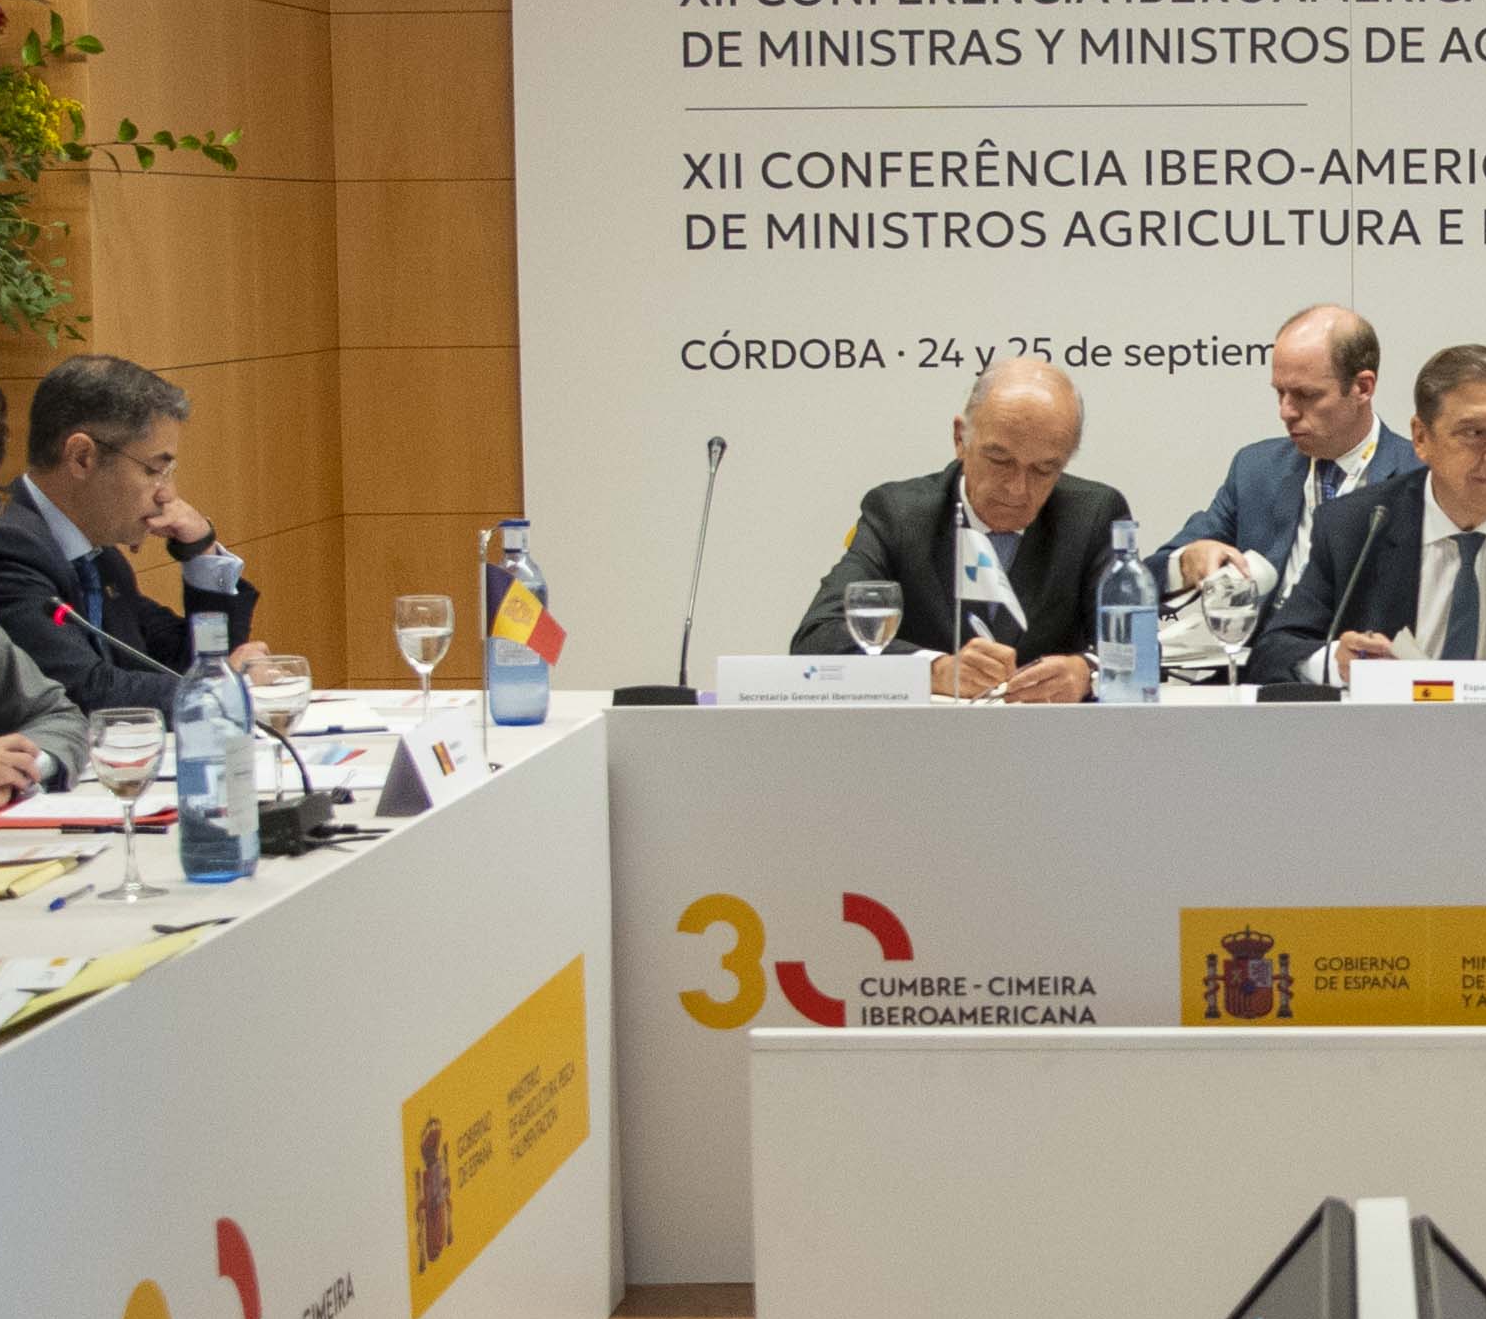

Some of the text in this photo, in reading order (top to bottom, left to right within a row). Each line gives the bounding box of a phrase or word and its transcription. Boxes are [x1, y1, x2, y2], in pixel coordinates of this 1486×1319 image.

[682, 31, 743, 68] DE
[759, 28, 1022, 67] MINISTRAS
[1036, 28, 1065, 64] Y
[1079, 26, 1350, 65] MINISTROS
[1365, 26, 1425, 64] DE
[682, 152, 743, 190] XII
[761, 138, 1127, 189] CONFERÊNCIA
[686, 213, 747, 250] DE
[766, 210, 1047, 249] MINISTROS
[1063, 208, 1421, 248] AGRICULTURA
[1439, 208, 1464, 245] E
[680, 330, 885, 370] CÓRDOBA
[917, 338, 964, 369] 24
[975, 344, 996, 375] y
[1064, 335, 1112, 367] de
[1124, 334, 1276, 374] septiem
[1314, 956, 1410, 972] GOBIERNO
[860, 976, 966, 998] CUMBRE
[987, 976, 1097, 997] CIMEIRA
[1314, 972, 1410, 990] DE ESPAÑA
[1462, 975, 1485, 990] DE
[1462, 994, 1474, 1008] Y
[861, 1005, 1097, 1026] IBEROAMERICANA
